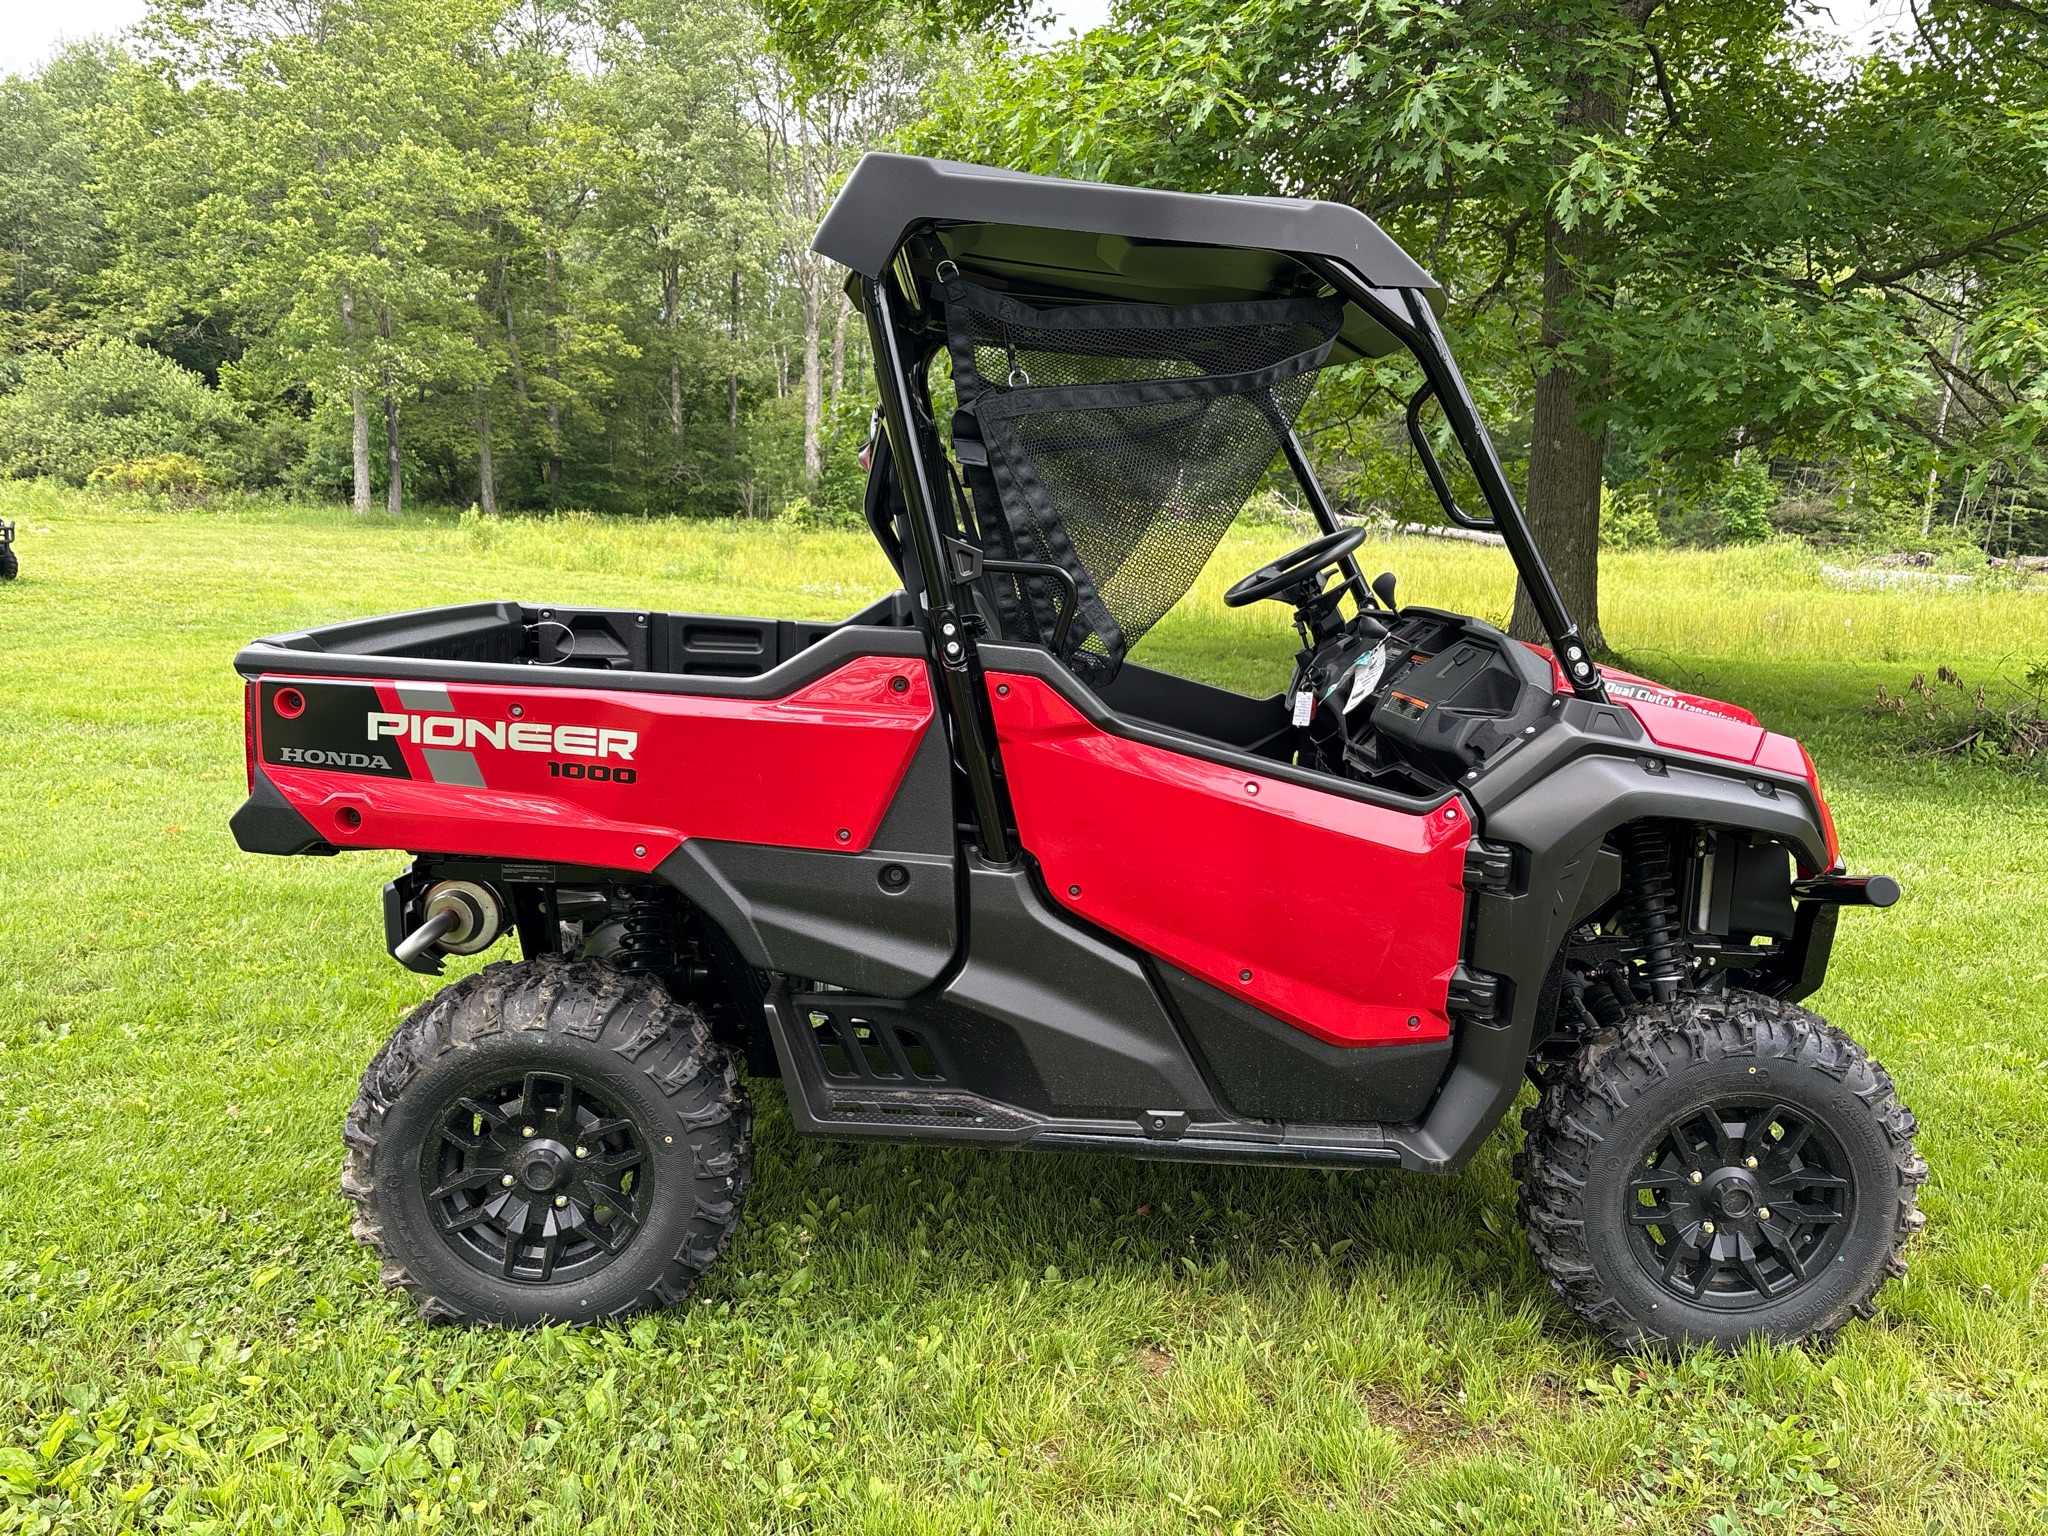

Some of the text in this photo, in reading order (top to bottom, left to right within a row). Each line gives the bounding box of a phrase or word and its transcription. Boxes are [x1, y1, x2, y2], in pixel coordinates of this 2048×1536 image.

[1605, 682, 1633, 698] Dual
[1635, 689, 1675, 708] Clutch
[367, 711, 639, 761] PIONEER
[280, 747, 392, 770] HONDA
[547, 761, 638, 785] 1000
[602, 1073, 665, 1129] ARMSTRONG
